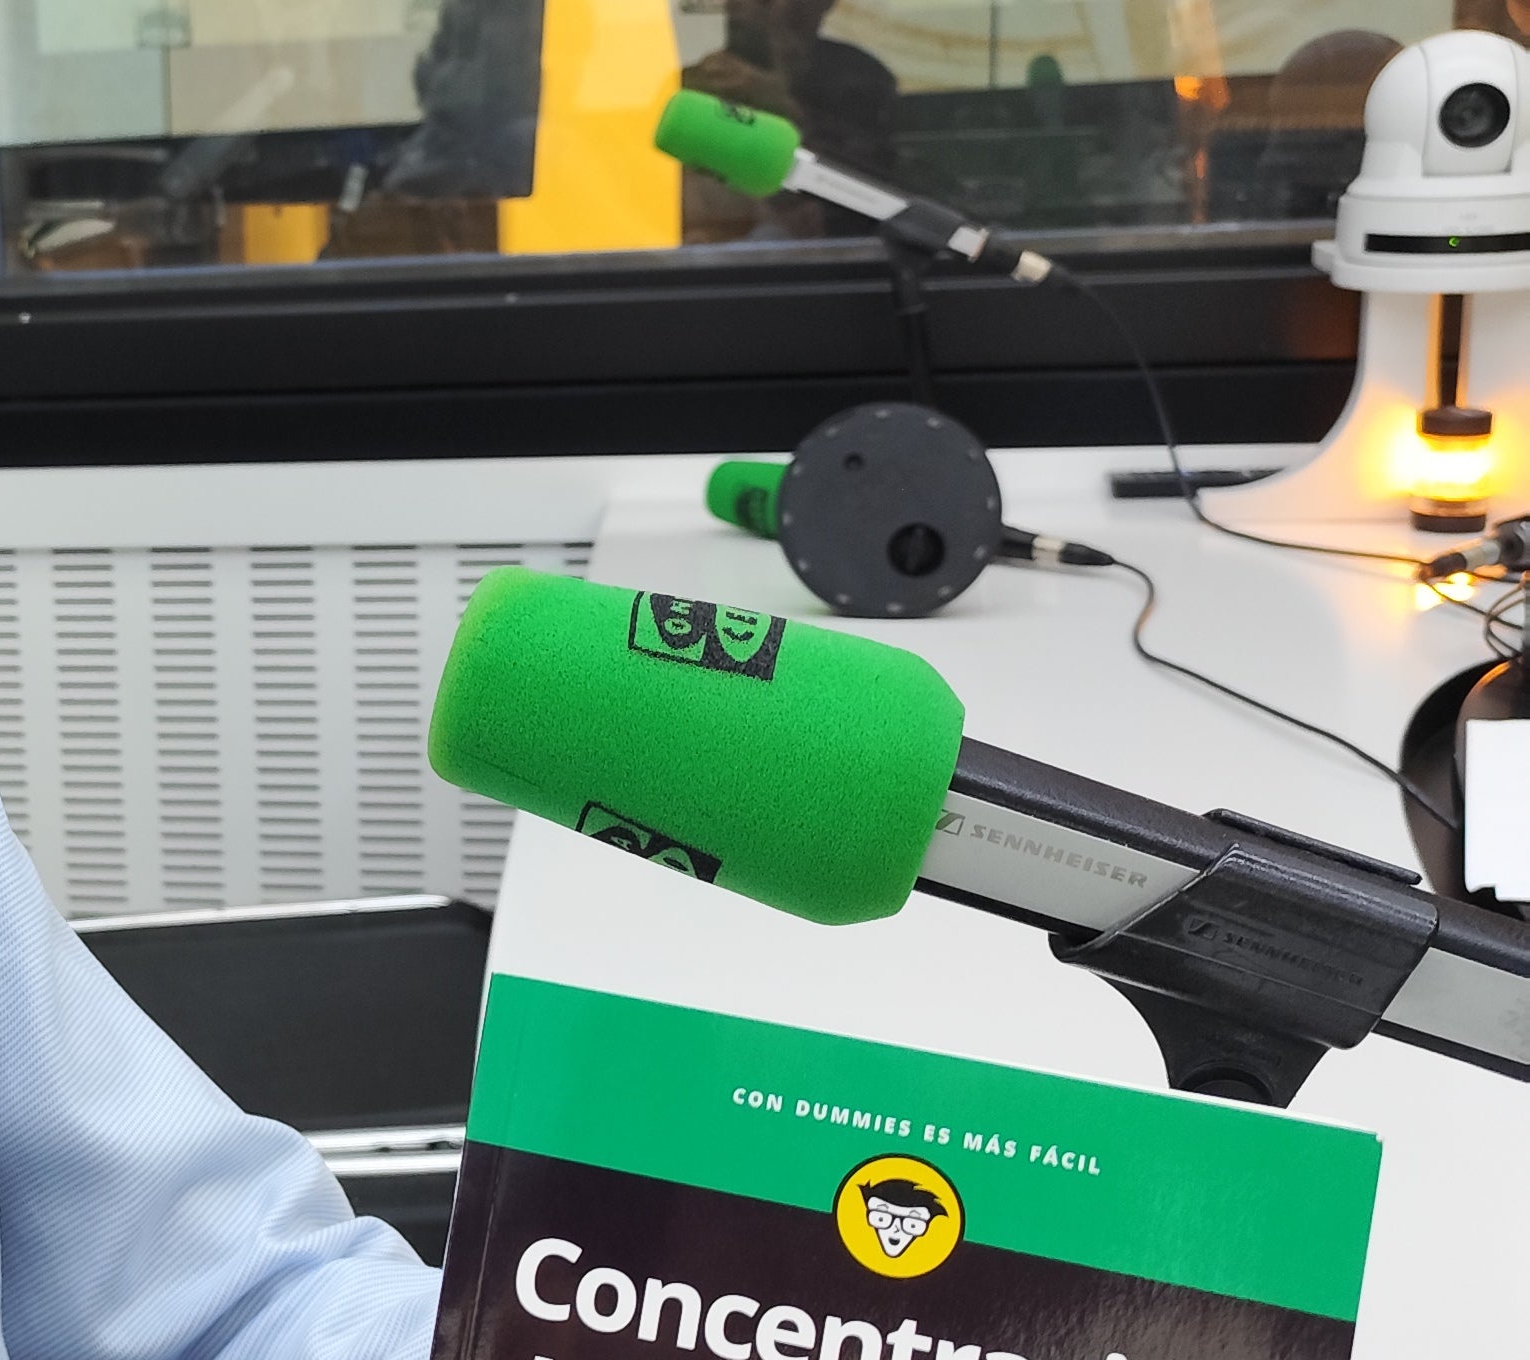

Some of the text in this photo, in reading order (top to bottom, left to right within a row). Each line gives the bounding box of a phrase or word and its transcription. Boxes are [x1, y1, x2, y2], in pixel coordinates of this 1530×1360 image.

[970, 823, 1148, 889] SENNHEISER
[732, 1087, 1102, 1176] CON DUMMIES ES MÁS FÁCIL
